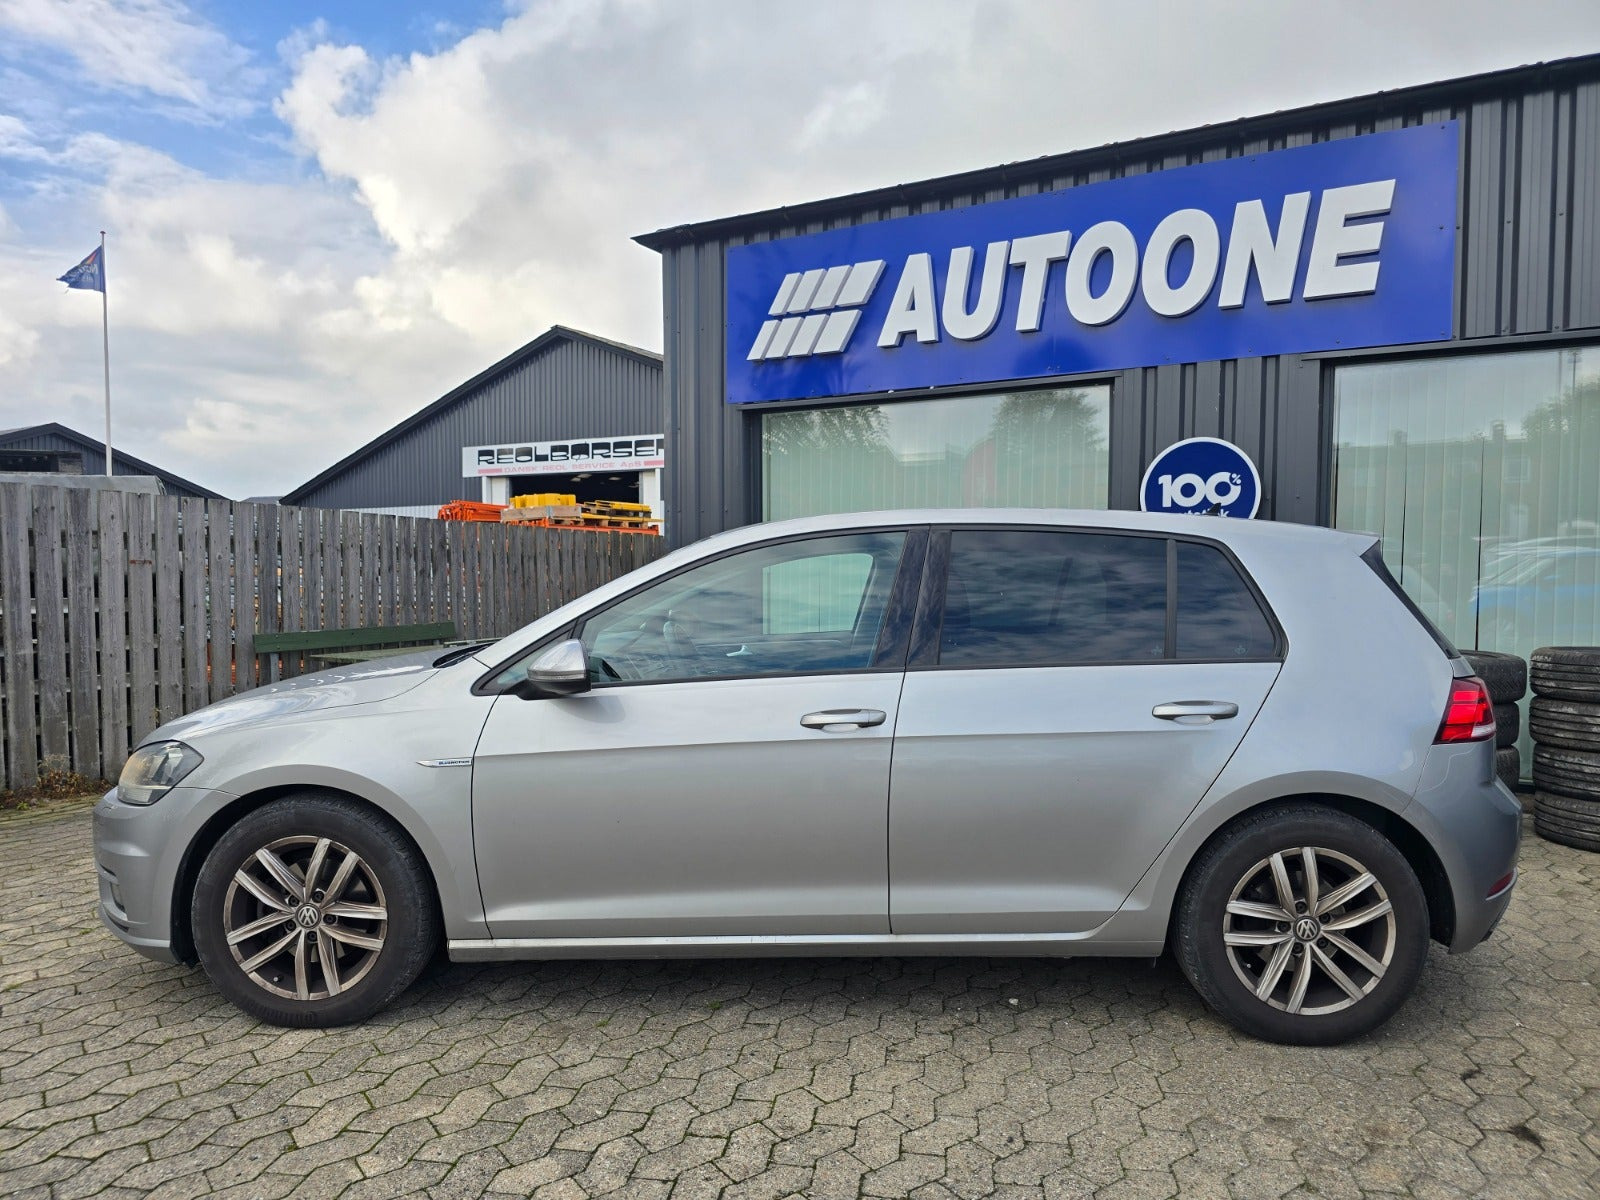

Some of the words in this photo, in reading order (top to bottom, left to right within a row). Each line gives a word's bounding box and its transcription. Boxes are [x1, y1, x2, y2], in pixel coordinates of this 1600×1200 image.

[876, 178, 1396, 348] AUTOONE
[504, 466, 539, 474] DANSK
[542, 464, 569, 472] REOL
[571, 462, 616, 470] SERVICE
[620, 460, 642, 468] ApS
